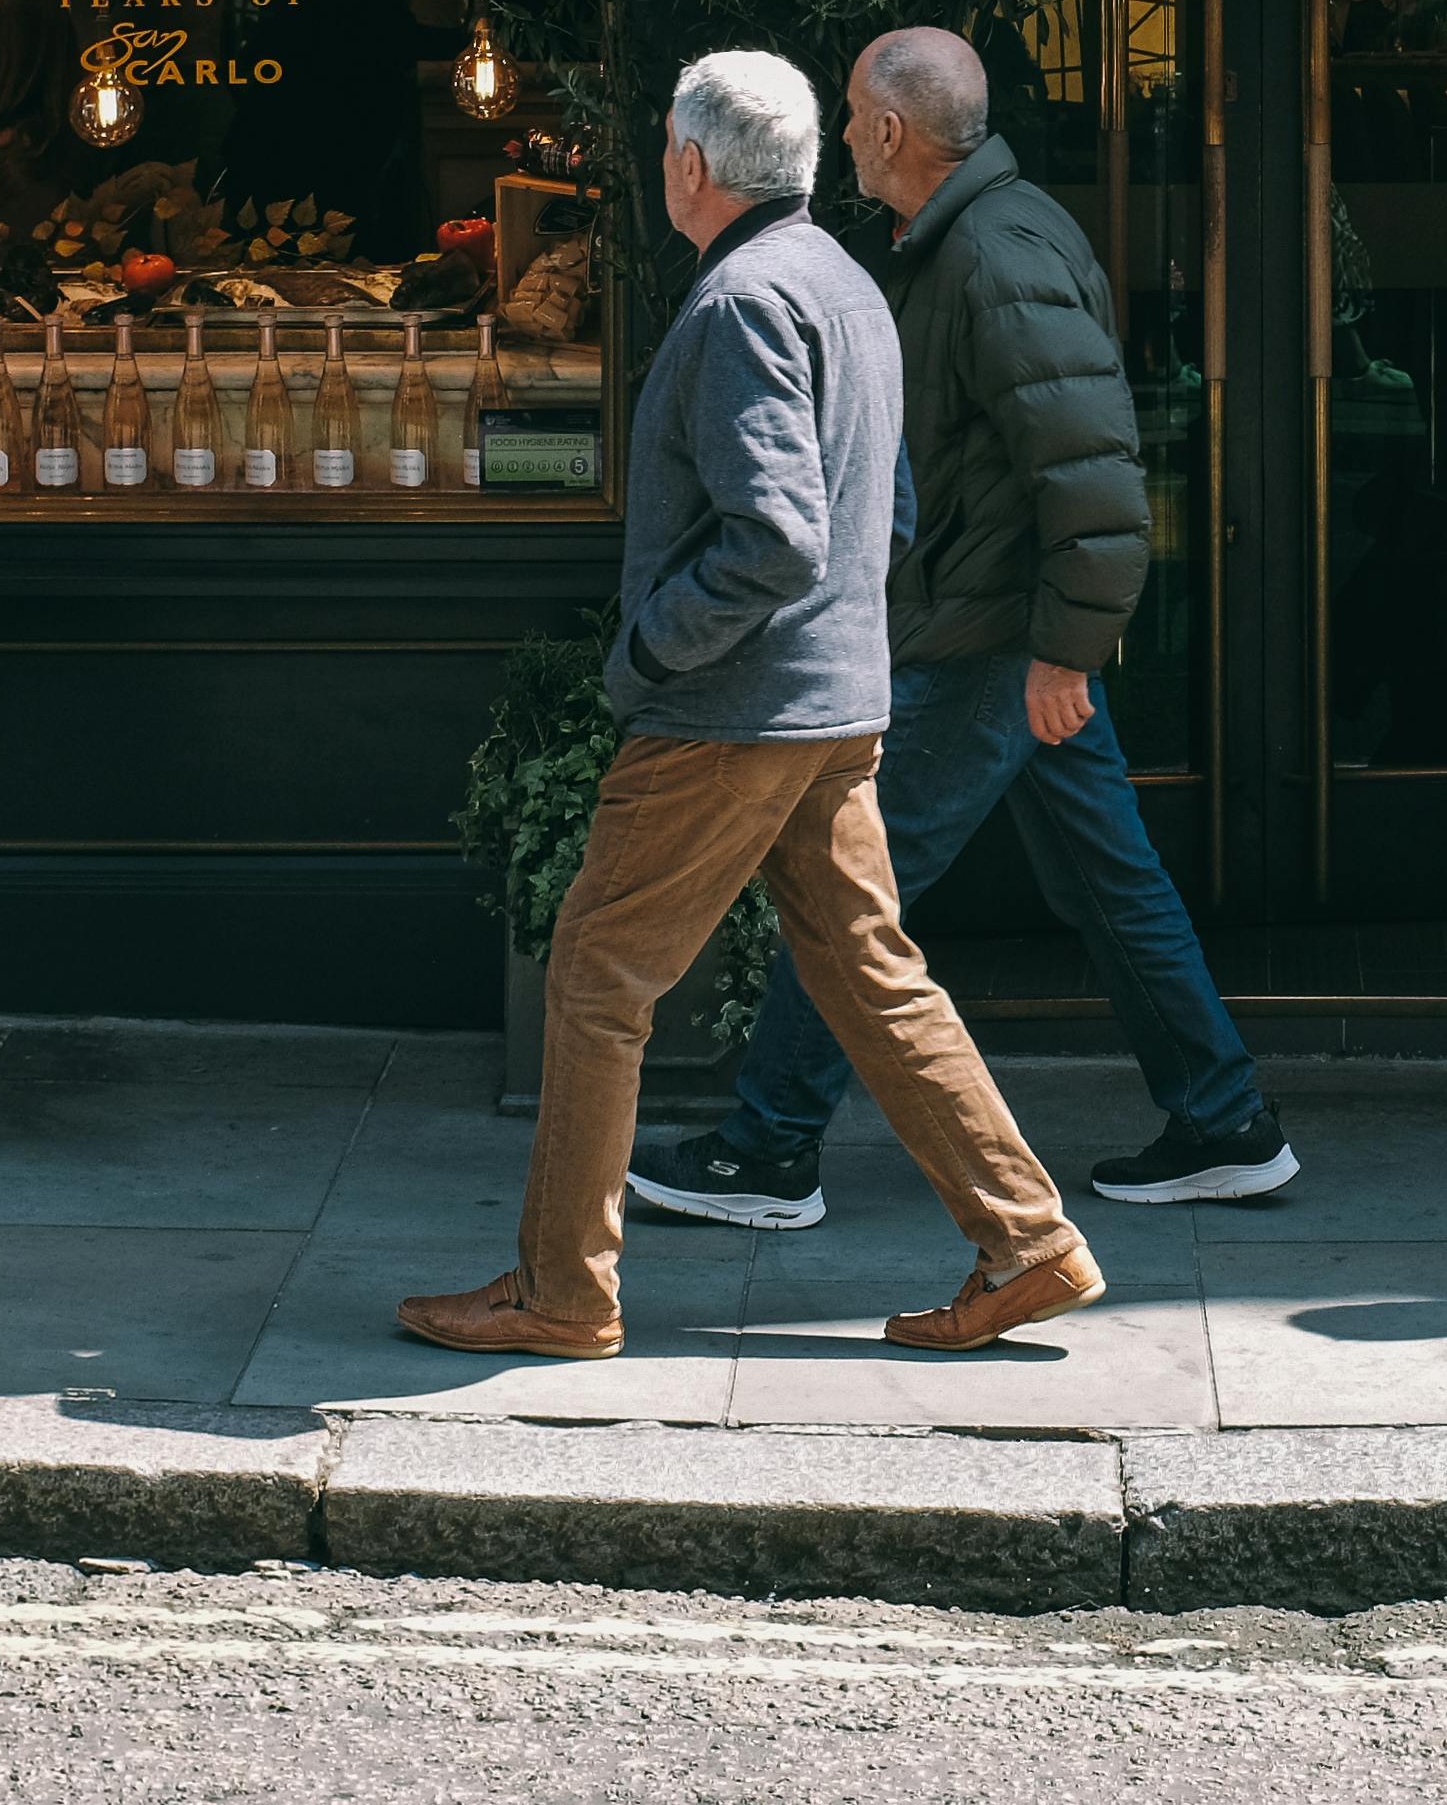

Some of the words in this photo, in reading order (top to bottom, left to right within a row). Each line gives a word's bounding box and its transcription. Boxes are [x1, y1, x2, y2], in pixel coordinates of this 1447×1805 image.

[80, 22, 188, 75] San
[124, 58, 284, 86] CARLO
[574, 459, 584, 474] 5
